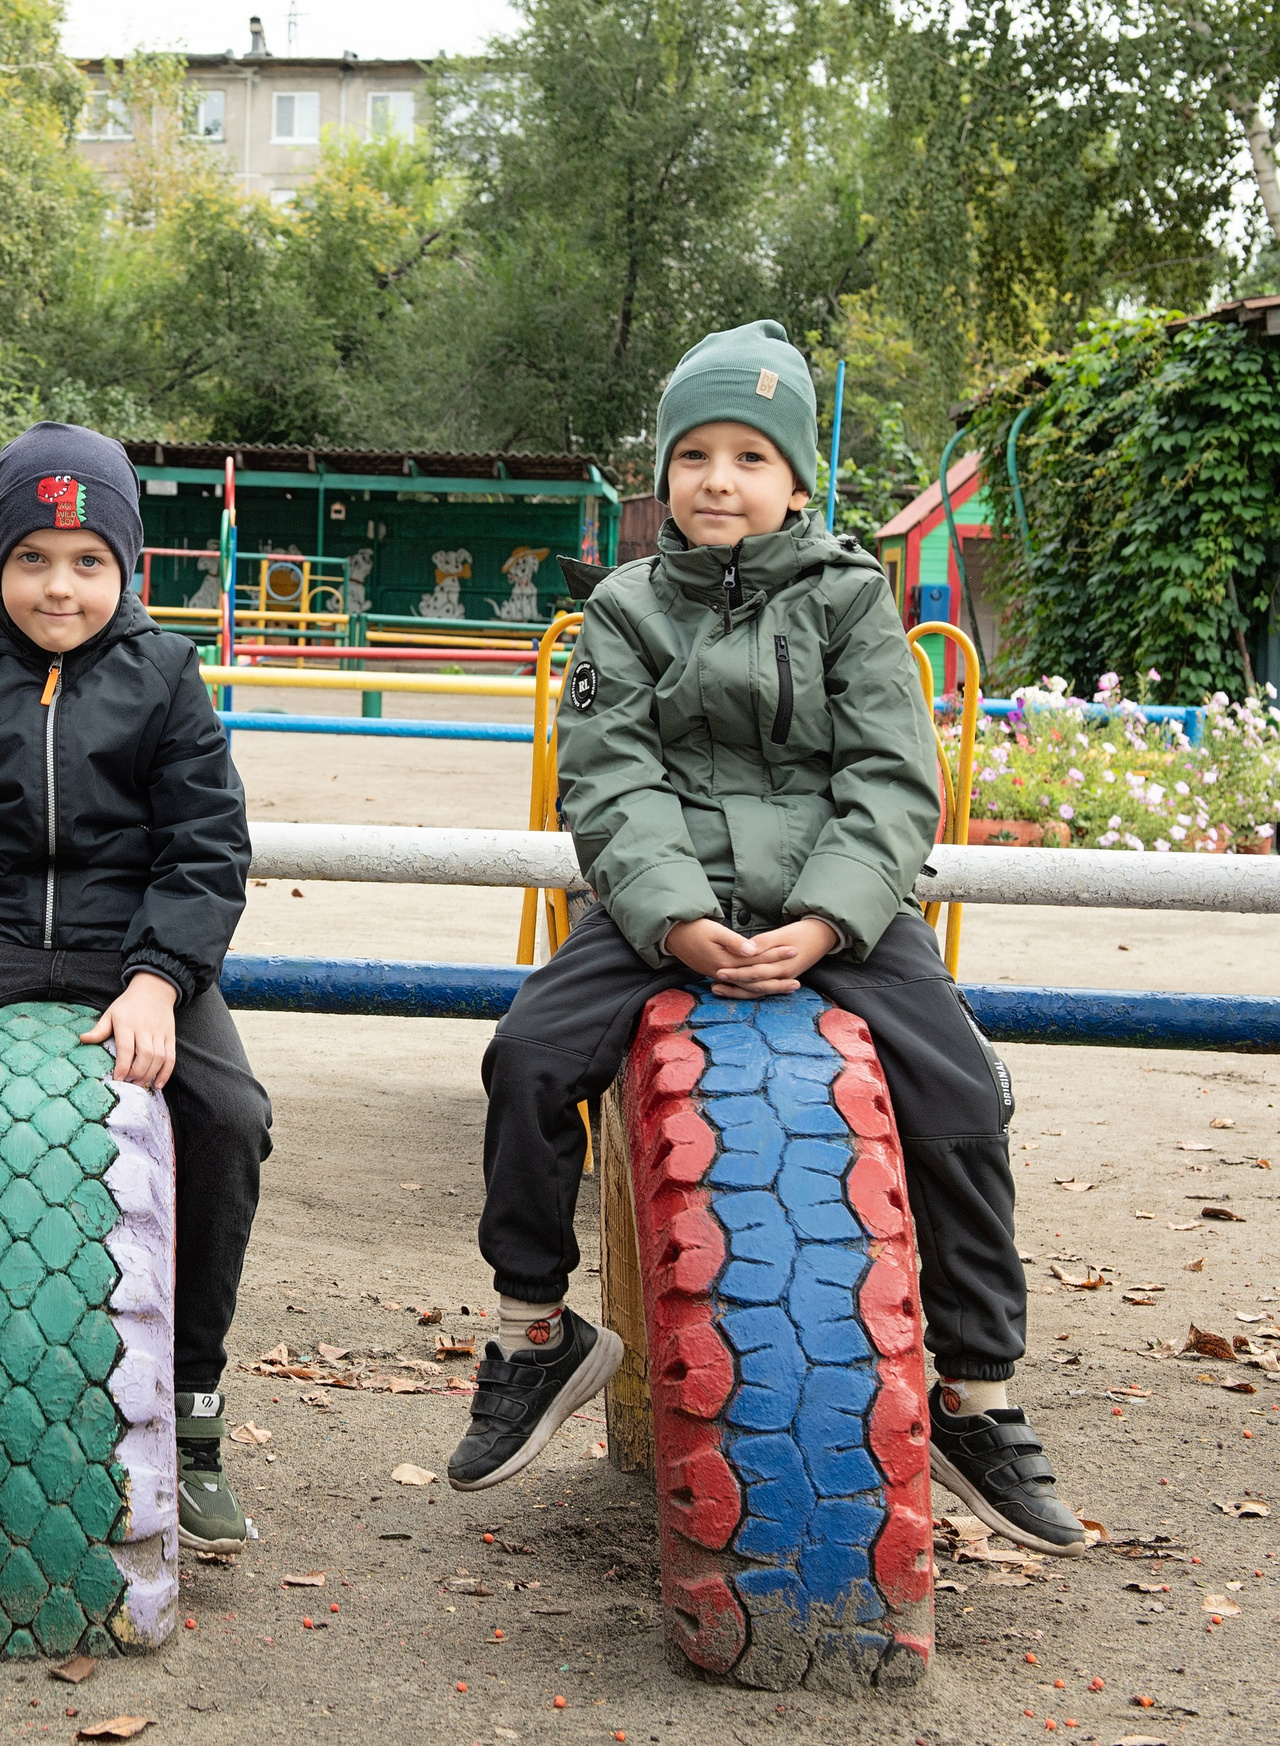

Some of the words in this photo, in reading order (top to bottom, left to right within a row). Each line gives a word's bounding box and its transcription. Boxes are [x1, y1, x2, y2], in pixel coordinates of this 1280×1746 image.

[56, 510, 77, 518] WILD
[60, 517, 76, 526] BOY
[578, 678, 590, 693] RL
[993, 1060, 1012, 1106] ORIGINAL
